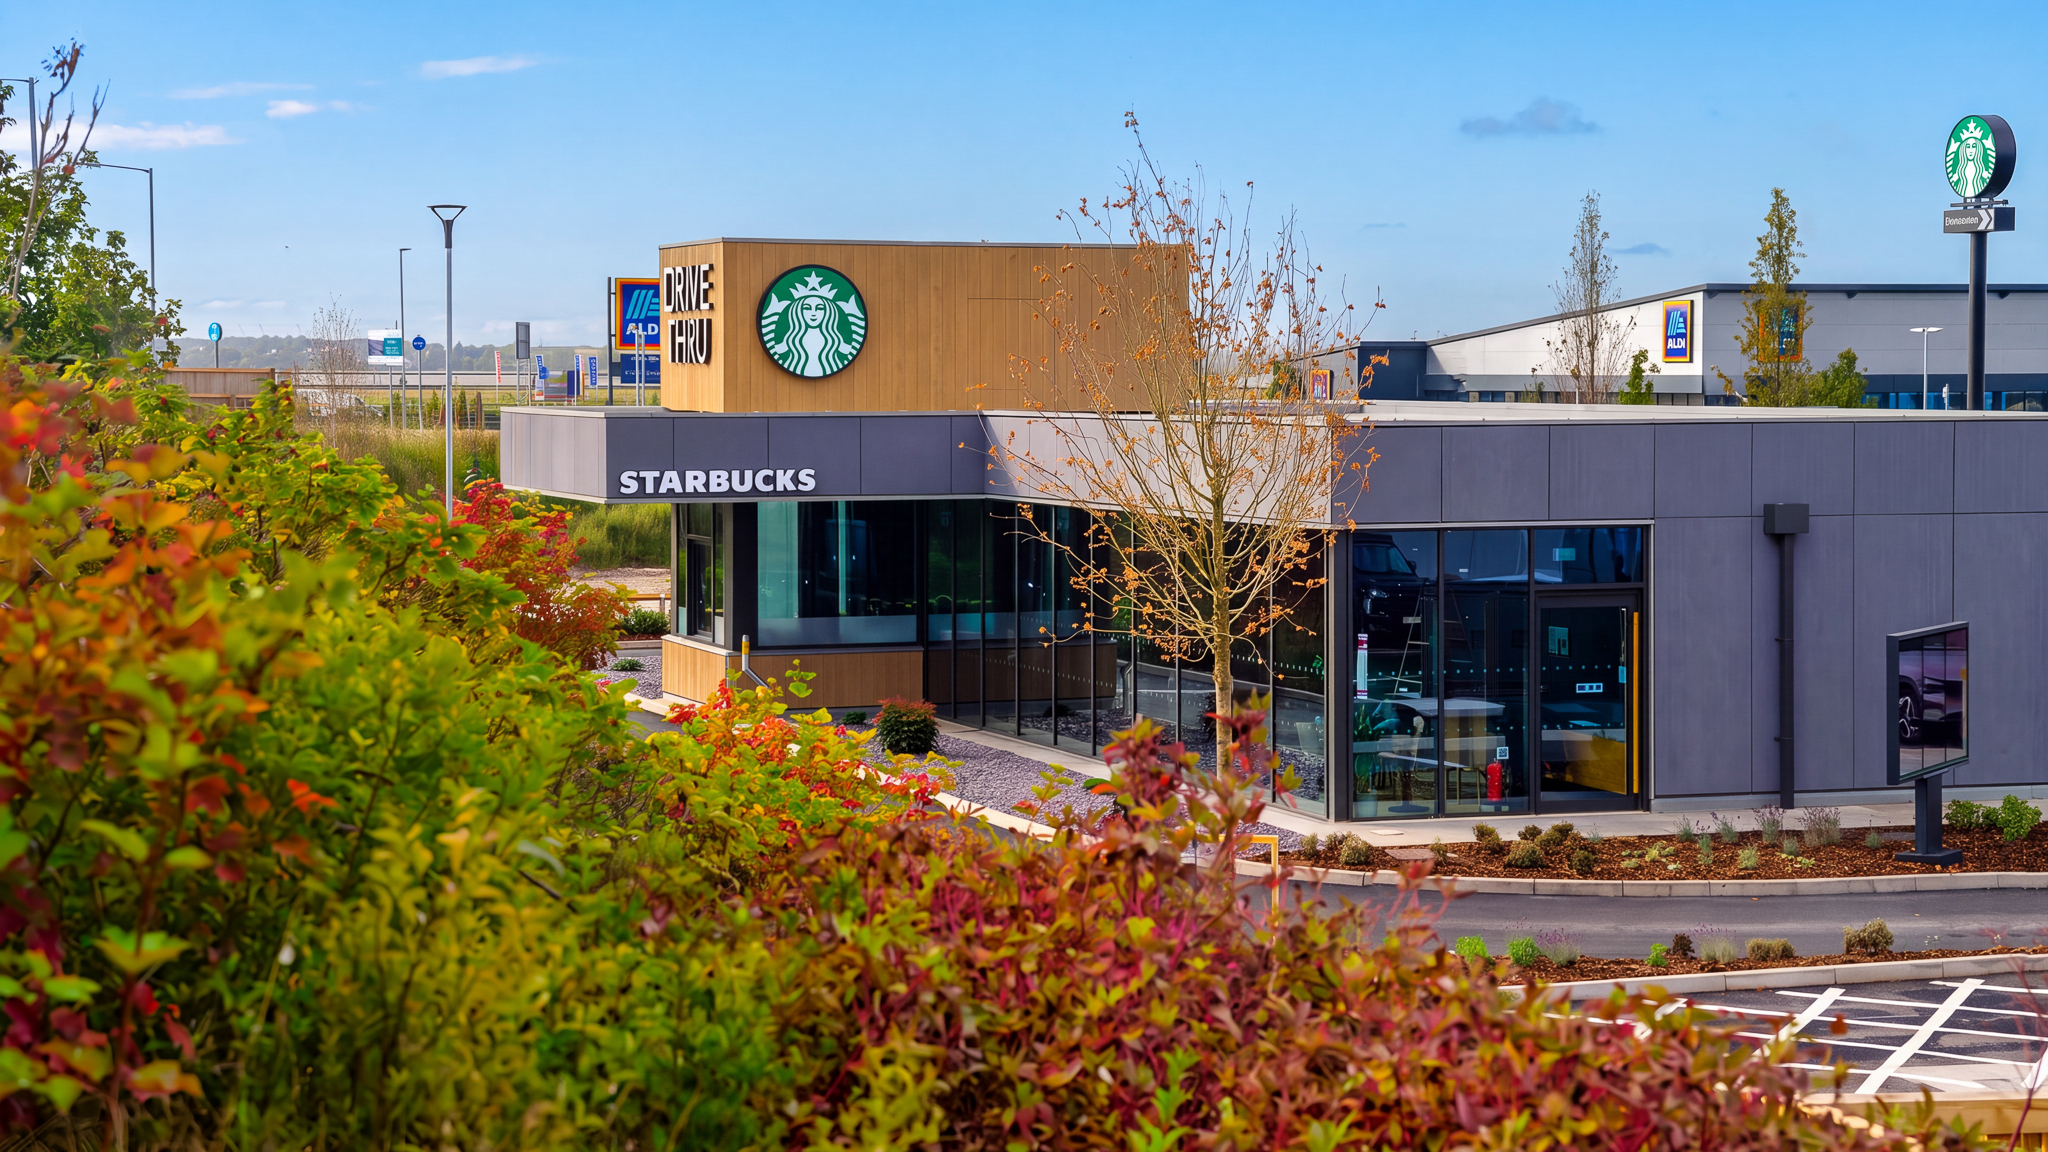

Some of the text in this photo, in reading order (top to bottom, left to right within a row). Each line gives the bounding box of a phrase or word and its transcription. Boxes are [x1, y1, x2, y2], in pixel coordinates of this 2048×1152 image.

[663, 263, 711, 313] DRIVE
[626, 323, 659, 335] ALD
[667, 318, 709, 364] THRU
[1667, 338, 1686, 349] ALDI
[619, 468, 817, 495] STARBUCKS
